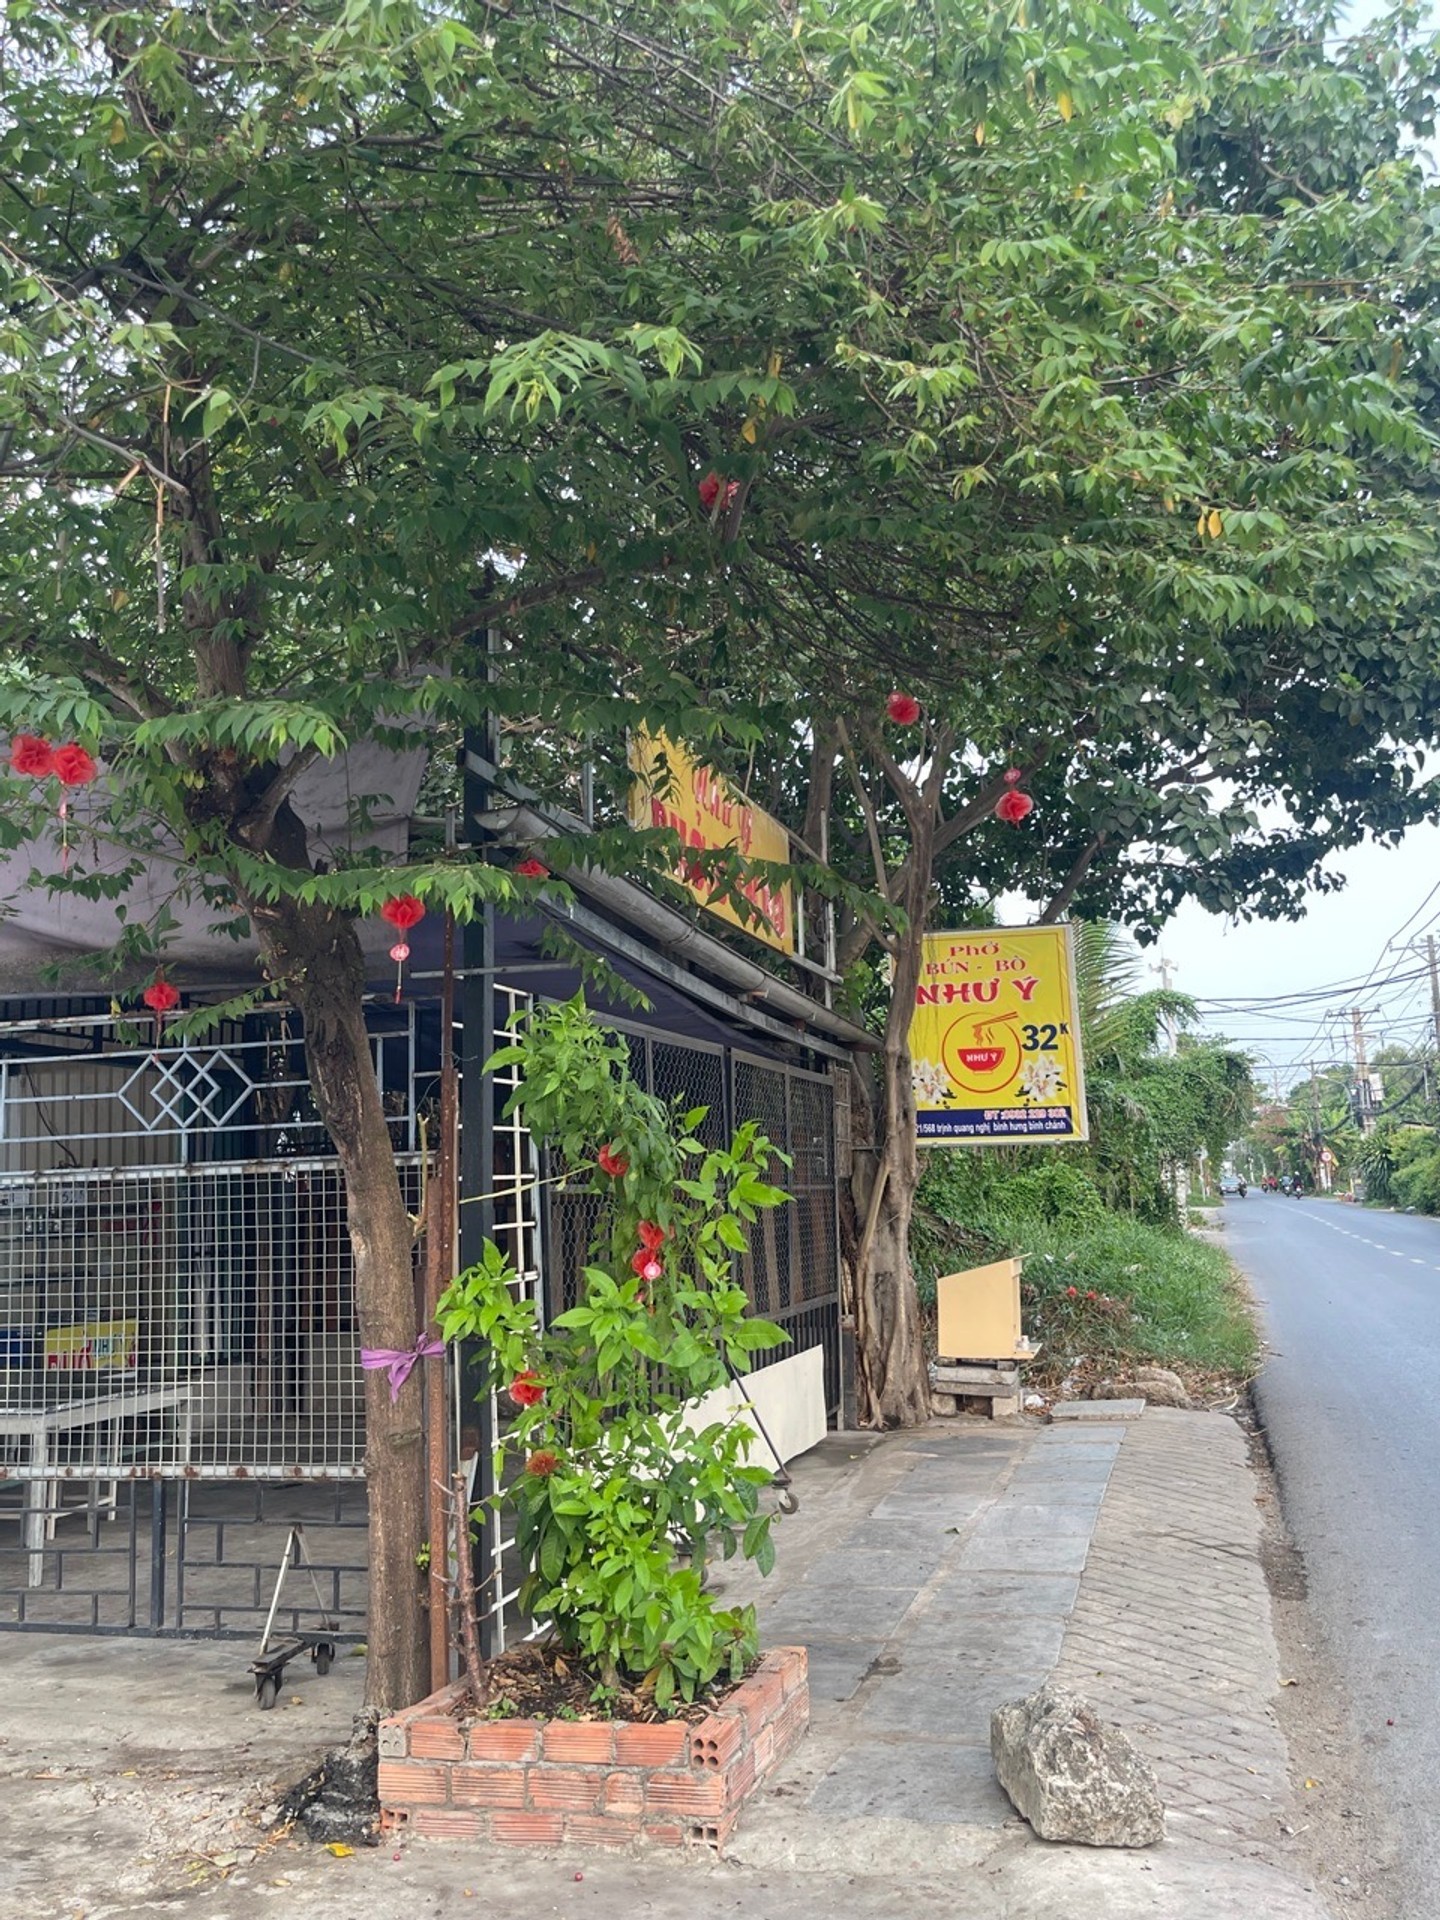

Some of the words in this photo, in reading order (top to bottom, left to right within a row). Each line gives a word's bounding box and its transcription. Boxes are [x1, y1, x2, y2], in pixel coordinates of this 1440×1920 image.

[926, 959, 969, 974] BÚN
[996, 955, 1026, 971] BÒ
[916, 978, 1000, 1005] NHƯ
[1012, 976, 1039, 1000] Ý
[953, 1124, 974, 1134] quang
